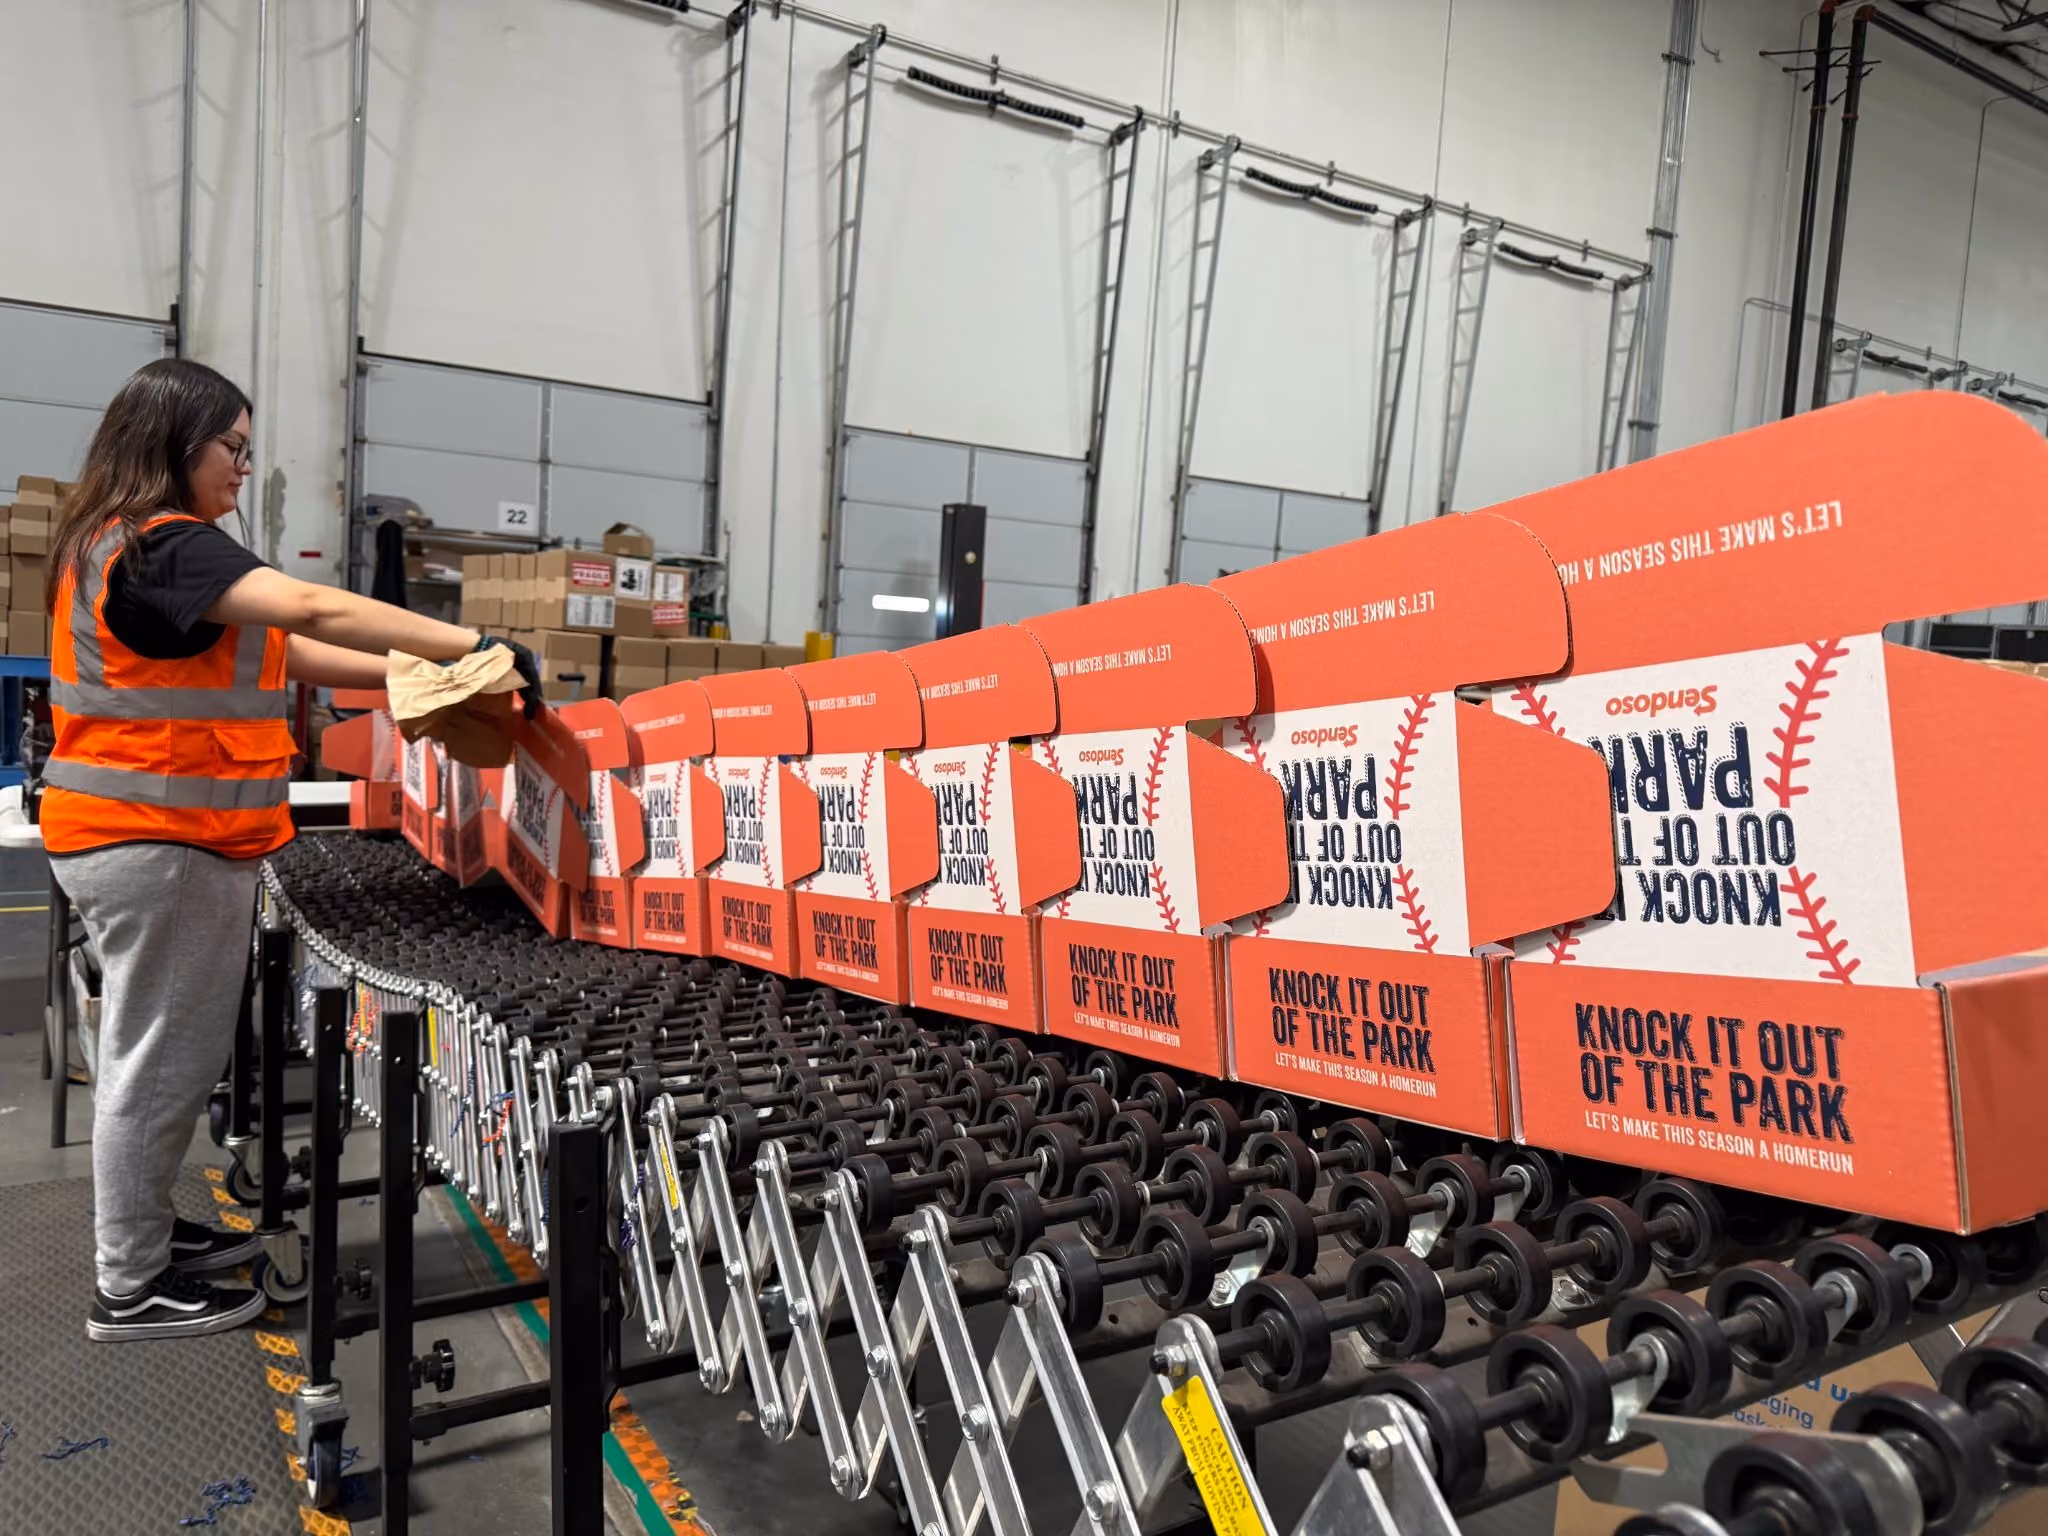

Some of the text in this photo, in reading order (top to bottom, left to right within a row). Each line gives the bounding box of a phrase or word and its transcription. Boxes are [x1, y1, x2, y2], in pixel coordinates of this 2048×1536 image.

[507, 508, 528, 525] 22
[1718, 515, 1775, 552] MAKE
[1783, 500, 1843, 538] LET'S
[1600, 542, 1665, 578] SEASON
[1671, 530, 1714, 562] THIS
[1584, 557, 1594, 581] A
[1333, 607, 1359, 630] THIS
[1362, 598, 1396, 624] MAKE
[1399, 590, 1436, 616] LET'S
[1280, 622, 1287, 640] A
[1289, 613, 1330, 639] SEASON
[1605, 685, 1718, 717] Sendoso
[1291, 724, 1359, 748] Sendoso
[1079, 748, 1124, 766] Sendoso
[1072, 772, 1139, 825] PARK
[949, 828, 962, 855] OF
[966, 828, 988, 855] OUT
[1099, 827, 1118, 860] OF
[1122, 826, 1156, 861] OUT
[1317, 822, 1345, 862] OF
[1352, 820, 1402, 864] OUT
[1652, 814, 1699, 867] OF
[1711, 810, 1796, 867] OUT
[945, 856, 986, 886] KNOCK
[1093, 860, 1150, 898] KNOCK
[1307, 864, 1393, 910] KNOCK
[1593, 868, 1782, 927] KNOCK I
[813, 910, 876, 942] KNOCK IT OUT
[815, 933, 878, 970] OF THE PARK
[928, 927, 1004, 964] KNOCK IT OUT
[930, 953, 1008, 995] OF THE PARK
[1069, 943, 1176, 992] KNOCK IT OUT
[1071, 974, 1180, 1030] OF THE PARK
[1269, 967, 1429, 1027] KNOCK IT OUT
[1272, 1005, 1437, 1075] OF THE PARK
[1576, 1002, 1845, 1081] KNOCK IT OUT
[1275, 1051, 1437, 1098] LET'S MAKE THIS SEASON A HOMERUN
[1580, 1051, 1854, 1144] OF THE PARK
[1585, 1110, 1854, 1176] LET'S MAKE THIS SEASON A HOMERUN
[1172, 1407, 1191, 1437] AWAY
[1187, 1438, 1205, 1473] FROM
[1202, 1473, 1227, 1525] MOVING
[1210, 1427, 1249, 1510] CAUTION
